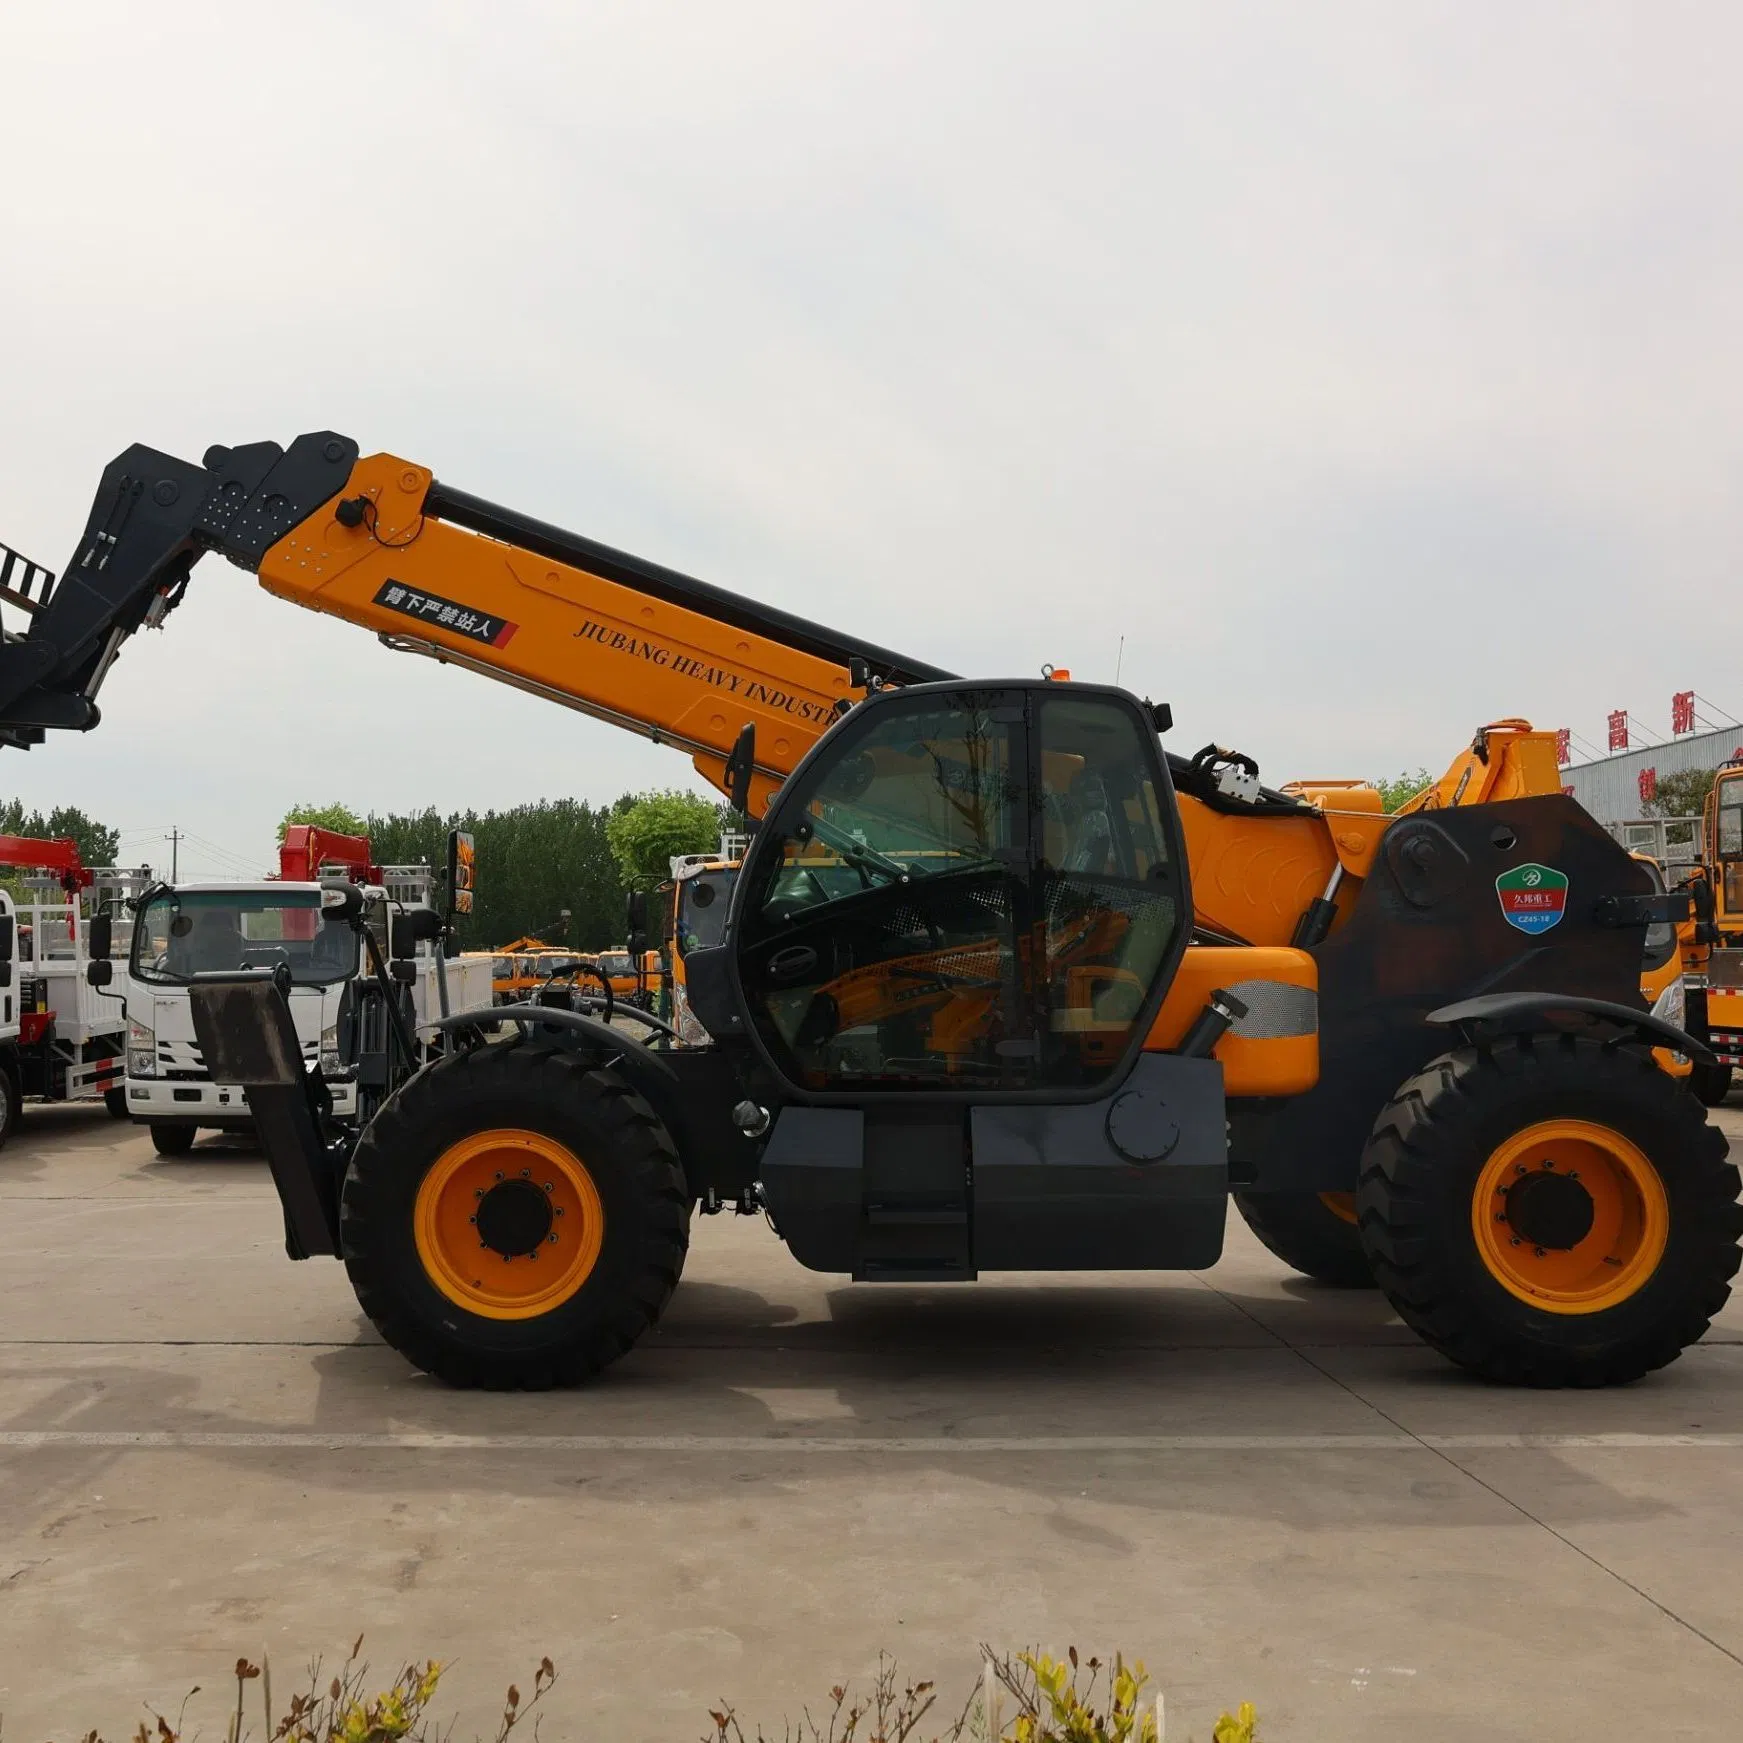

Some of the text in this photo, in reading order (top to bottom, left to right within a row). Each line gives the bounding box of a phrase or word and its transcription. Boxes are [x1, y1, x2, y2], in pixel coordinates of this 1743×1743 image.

[384, 586, 491, 637] 臂下严禁站人
[573, 620, 670, 665] JIUBANG
[669, 655, 745, 693] HEAVY
